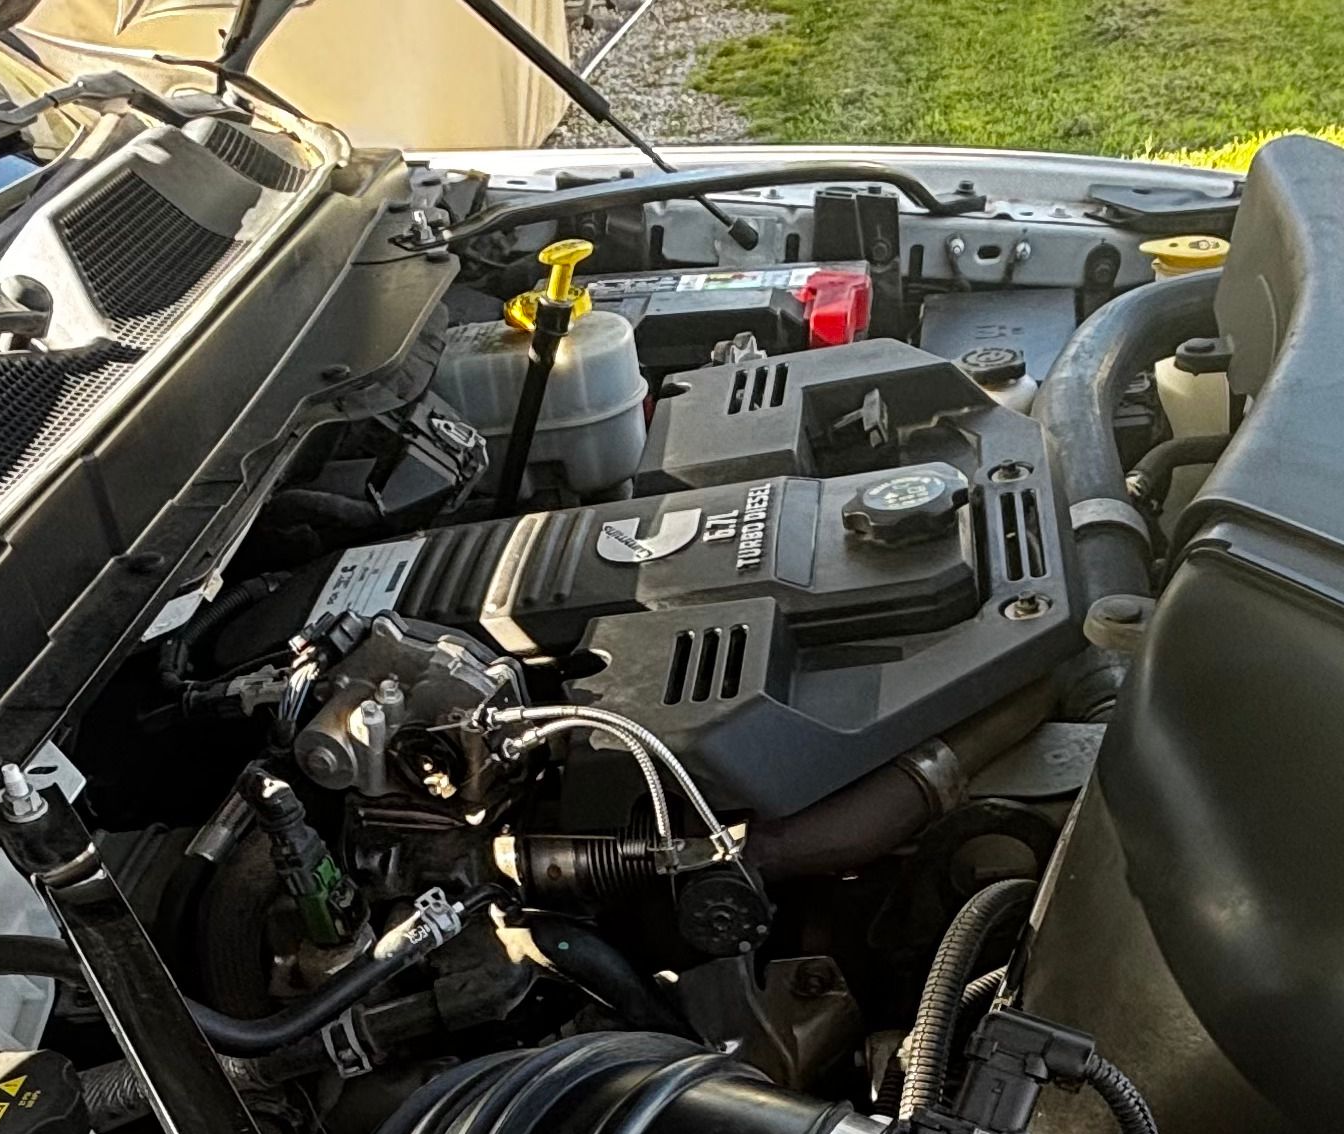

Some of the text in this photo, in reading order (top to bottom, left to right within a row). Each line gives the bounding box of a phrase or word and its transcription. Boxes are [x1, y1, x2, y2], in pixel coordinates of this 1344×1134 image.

[703, 508, 740, 543] 6.7L
[736, 483, 771, 571] TURBO DIESEL
